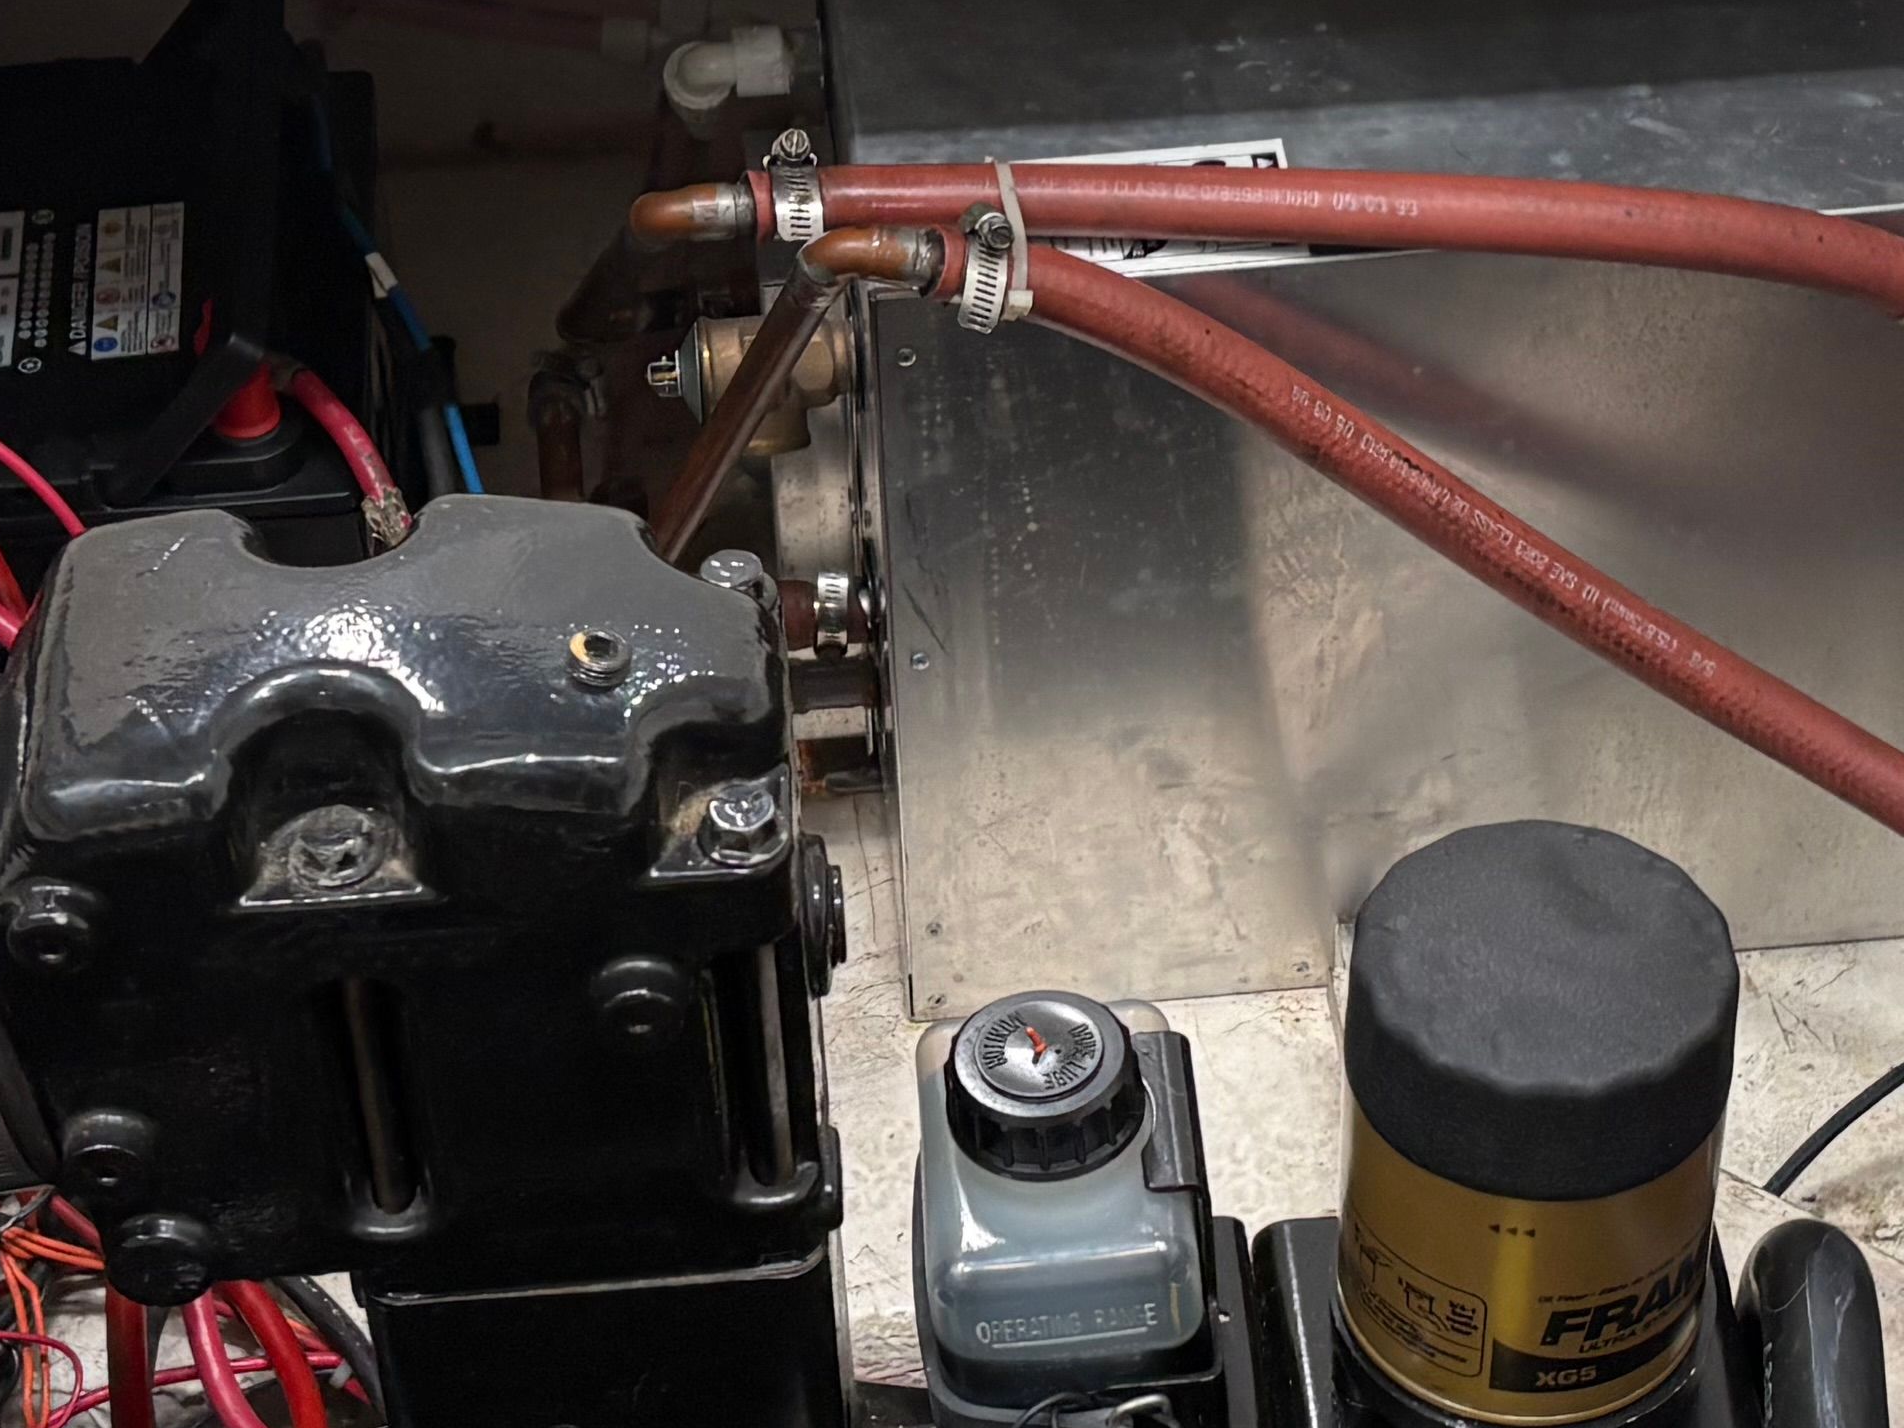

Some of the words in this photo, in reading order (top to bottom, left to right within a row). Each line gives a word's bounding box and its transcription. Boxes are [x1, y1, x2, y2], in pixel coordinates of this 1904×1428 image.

[1114, 180, 1167, 197] CLASS
[1544, 559, 1580, 592] SAE
[983, 1011, 1027, 1069] MONITOR
[1043, 1059, 1086, 1091] LUBE
[1540, 1254, 1703, 1347] FRAM
[975, 1311, 1081, 1344] OPERATING
[1094, 1302, 1158, 1332] RANGE
[1579, 1328, 1637, 1354] ULTRA
[1536, 1365, 1597, 1387] XG5
